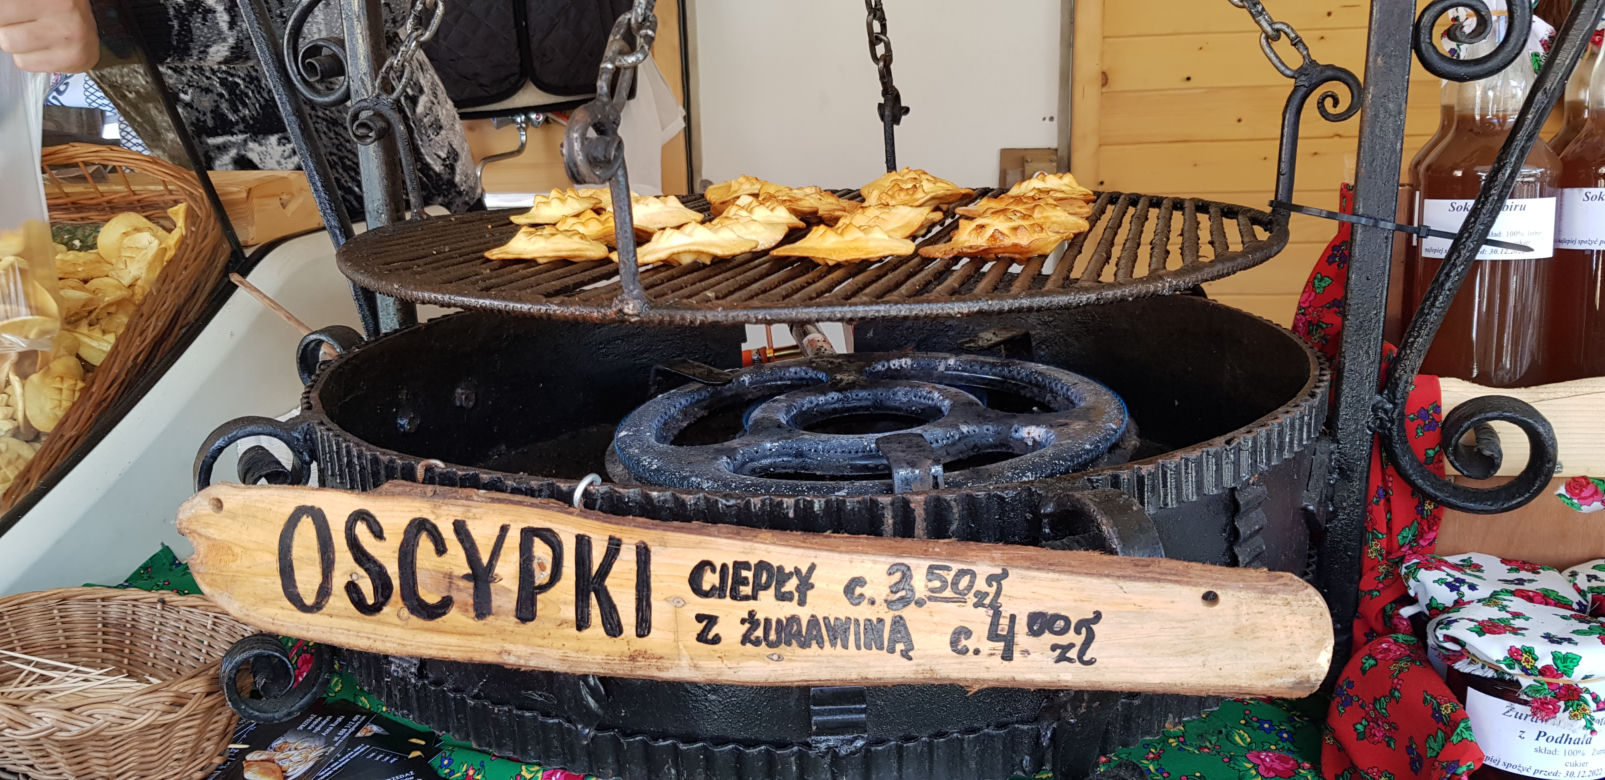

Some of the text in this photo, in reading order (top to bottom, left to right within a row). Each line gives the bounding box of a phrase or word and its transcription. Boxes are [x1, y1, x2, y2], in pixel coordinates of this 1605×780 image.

[1582, 191, 1605, 202] Sok
[1448, 202, 1471, 213] Sok
[278, 504, 652, 638] OSCYPKI
[688, 559, 817, 608] CIEPŁY
[740, 610, 915, 661] ŻURAWINĄ
[1535, 730, 1592, 746] Podhala
[1534, 746, 1560, 756] skład:
[1533, 766, 1562, 778] przed:
